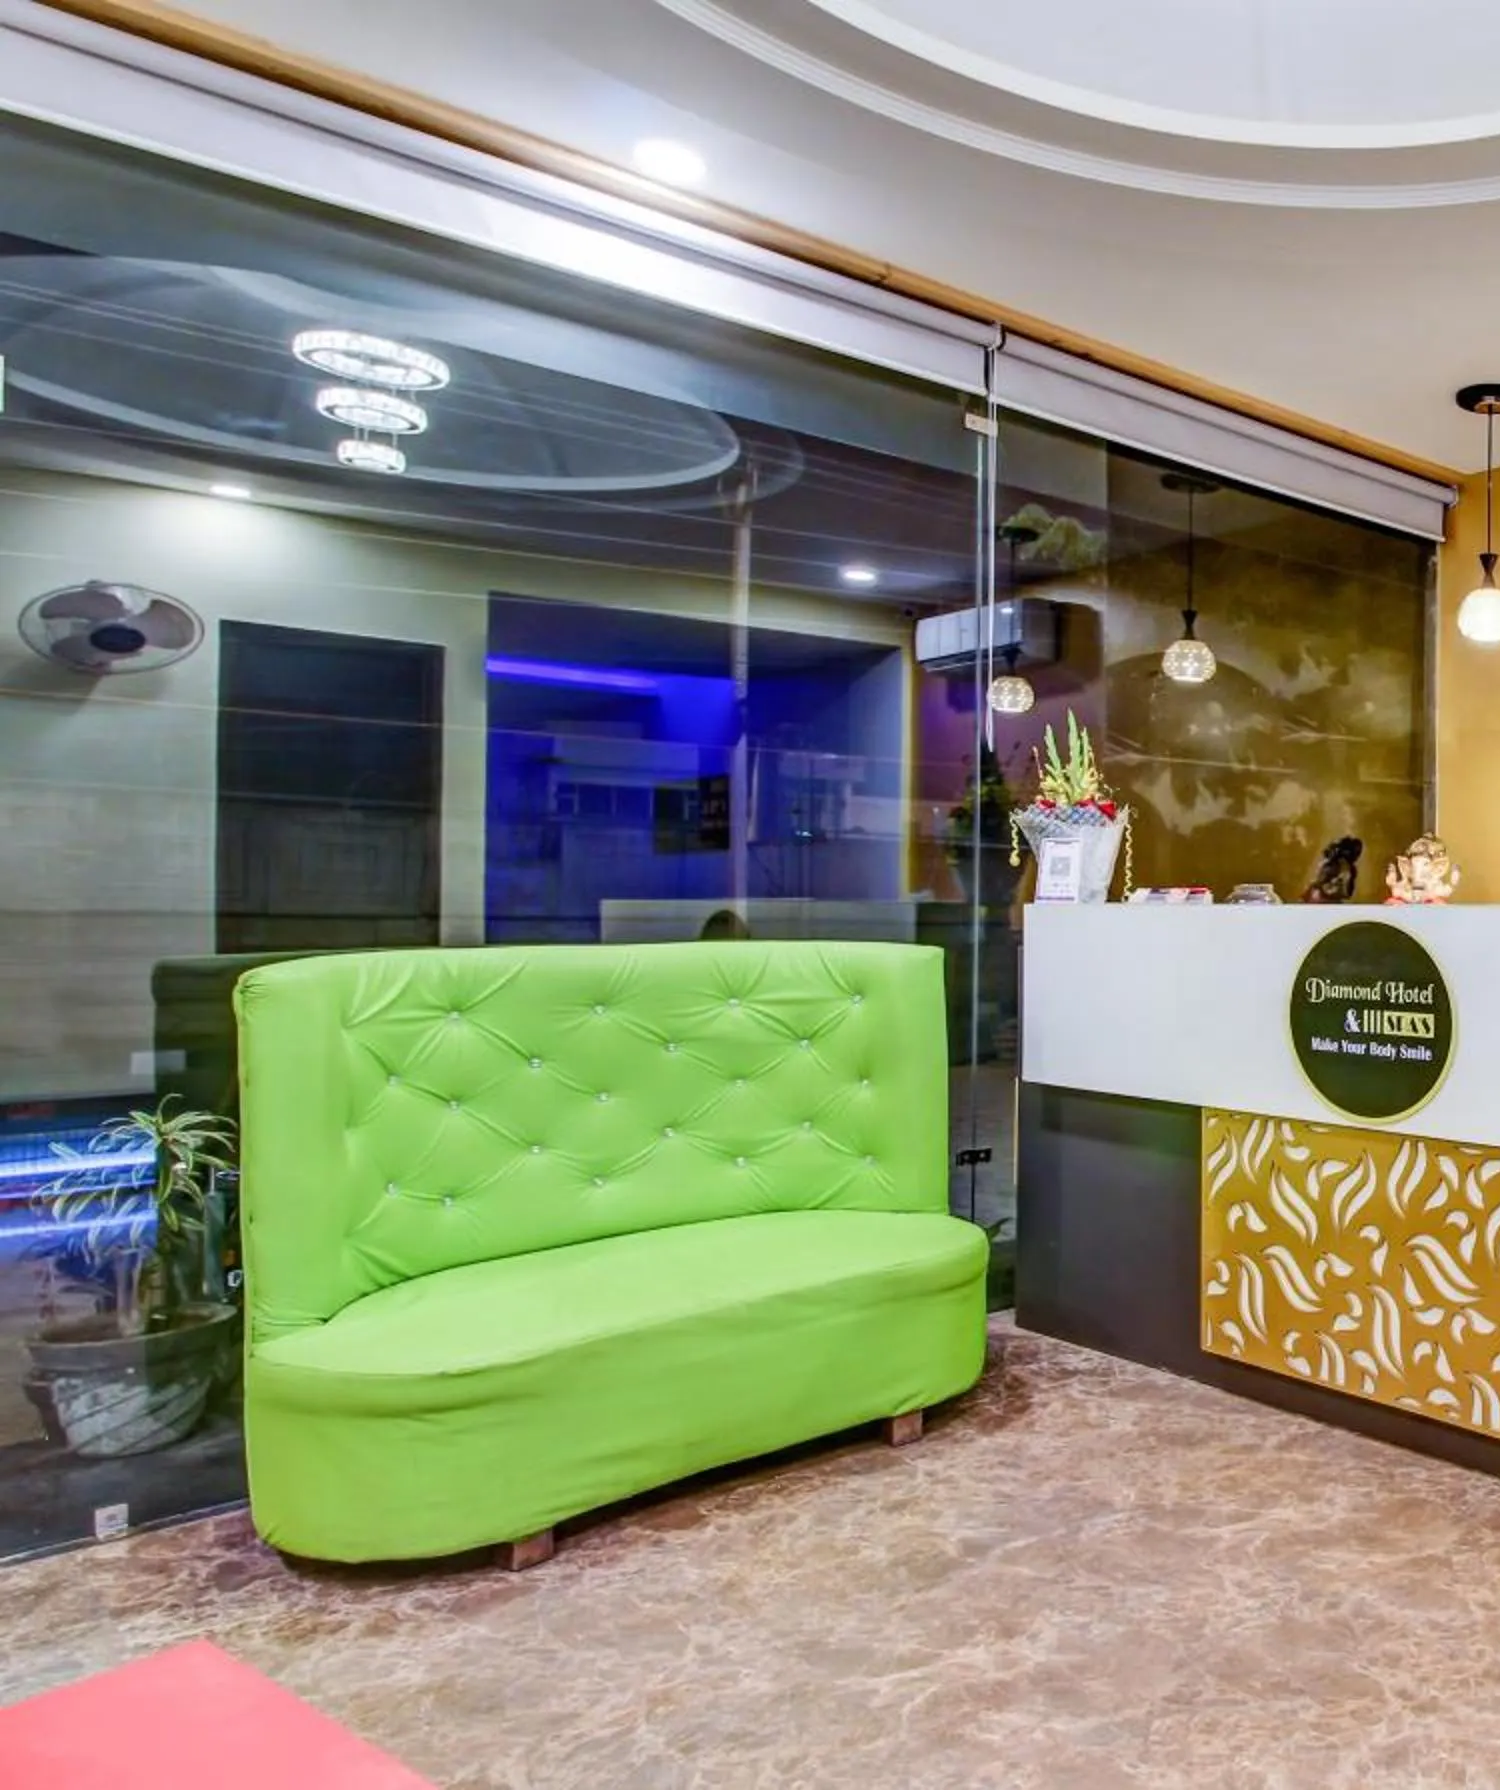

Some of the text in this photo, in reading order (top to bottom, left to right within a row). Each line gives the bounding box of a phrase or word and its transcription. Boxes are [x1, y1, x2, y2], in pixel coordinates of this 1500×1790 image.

[1305, 977, 1435, 1005] Diamond Hotel
[1344, 1008, 1361, 1033] &
[1311, 1036, 1433, 1061] Make Your Body Smile
